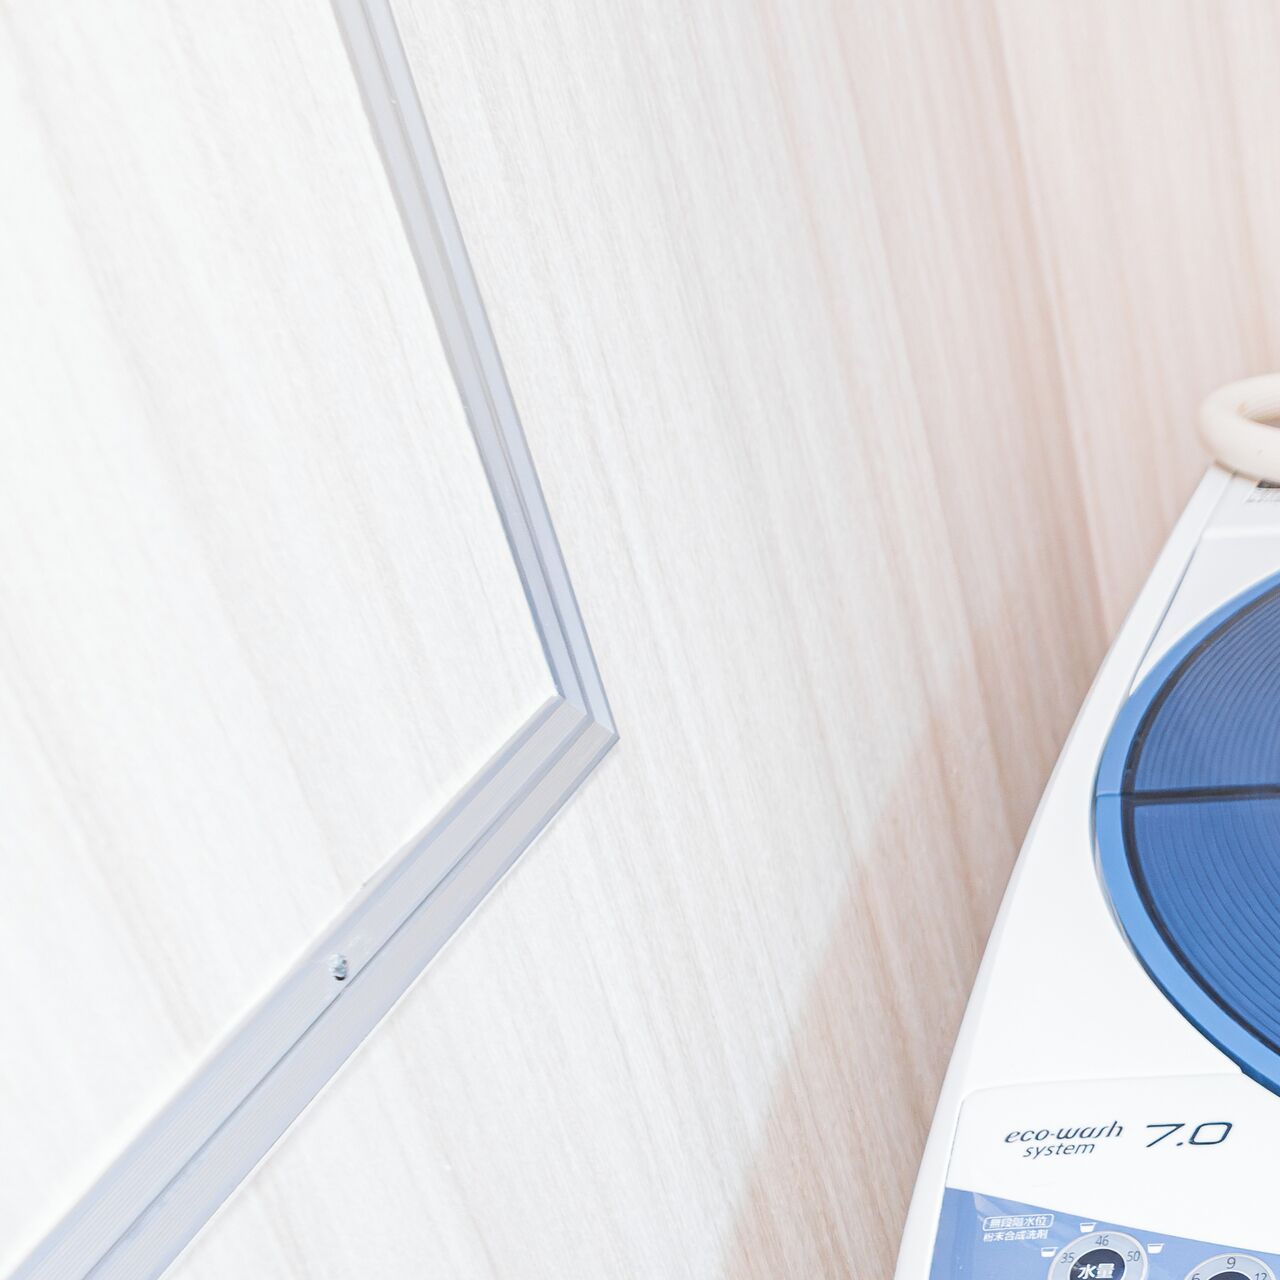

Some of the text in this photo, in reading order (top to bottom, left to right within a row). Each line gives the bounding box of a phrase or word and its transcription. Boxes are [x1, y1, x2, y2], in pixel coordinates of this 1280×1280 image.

[1004, 1121, 1233, 1148] eco-wash 7.0
[1022, 1143, 1096, 1160] system
[1095, 1236, 1110, 1246] 46
[1060, 1252, 1075, 1263] 35
[1126, 1251, 1141, 1262] 50
[1226, 1256, 1236, 1269] 9
[1077, 1263, 1116, 1280] 水量
